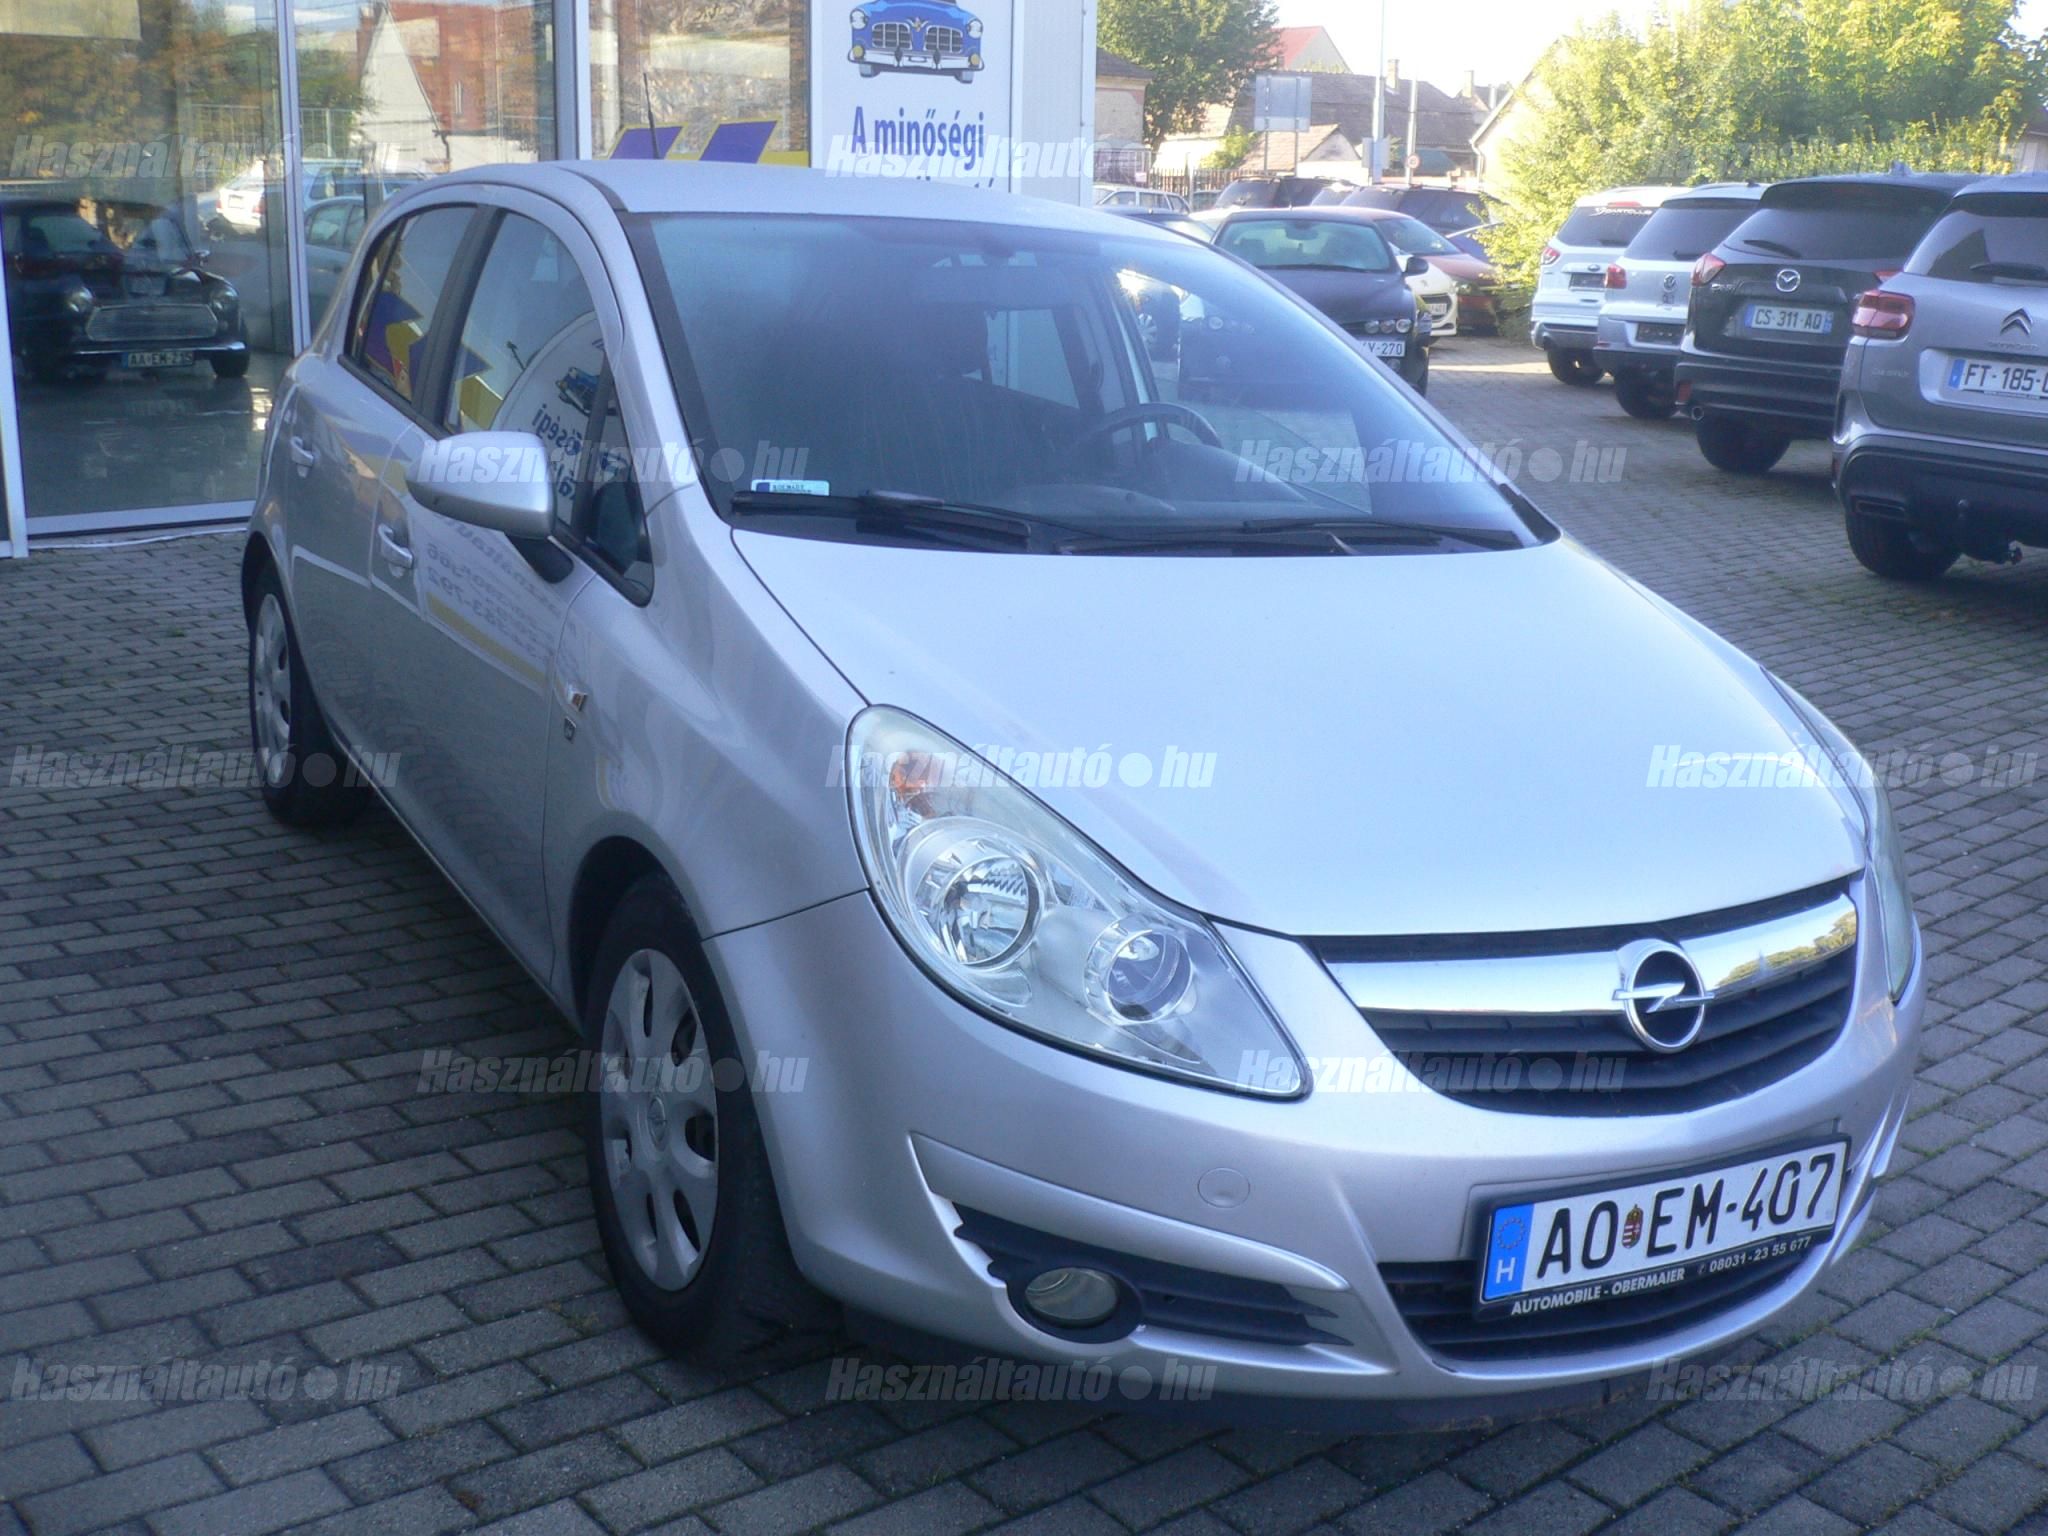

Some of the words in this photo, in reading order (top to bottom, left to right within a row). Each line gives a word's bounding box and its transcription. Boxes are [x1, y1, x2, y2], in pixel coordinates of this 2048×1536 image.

[851, 106, 867, 154] A
[874, 107, 985, 171] minőségi
[1496, 1258, 1517, 1284] H
[1510, 1285, 1600, 1316] AUTOMOBILE
[1611, 1267, 1686, 1297] OBERMAIER
[1771, 1241, 1787, 1257] 55
[1789, 1235, 1812, 1252] 677
